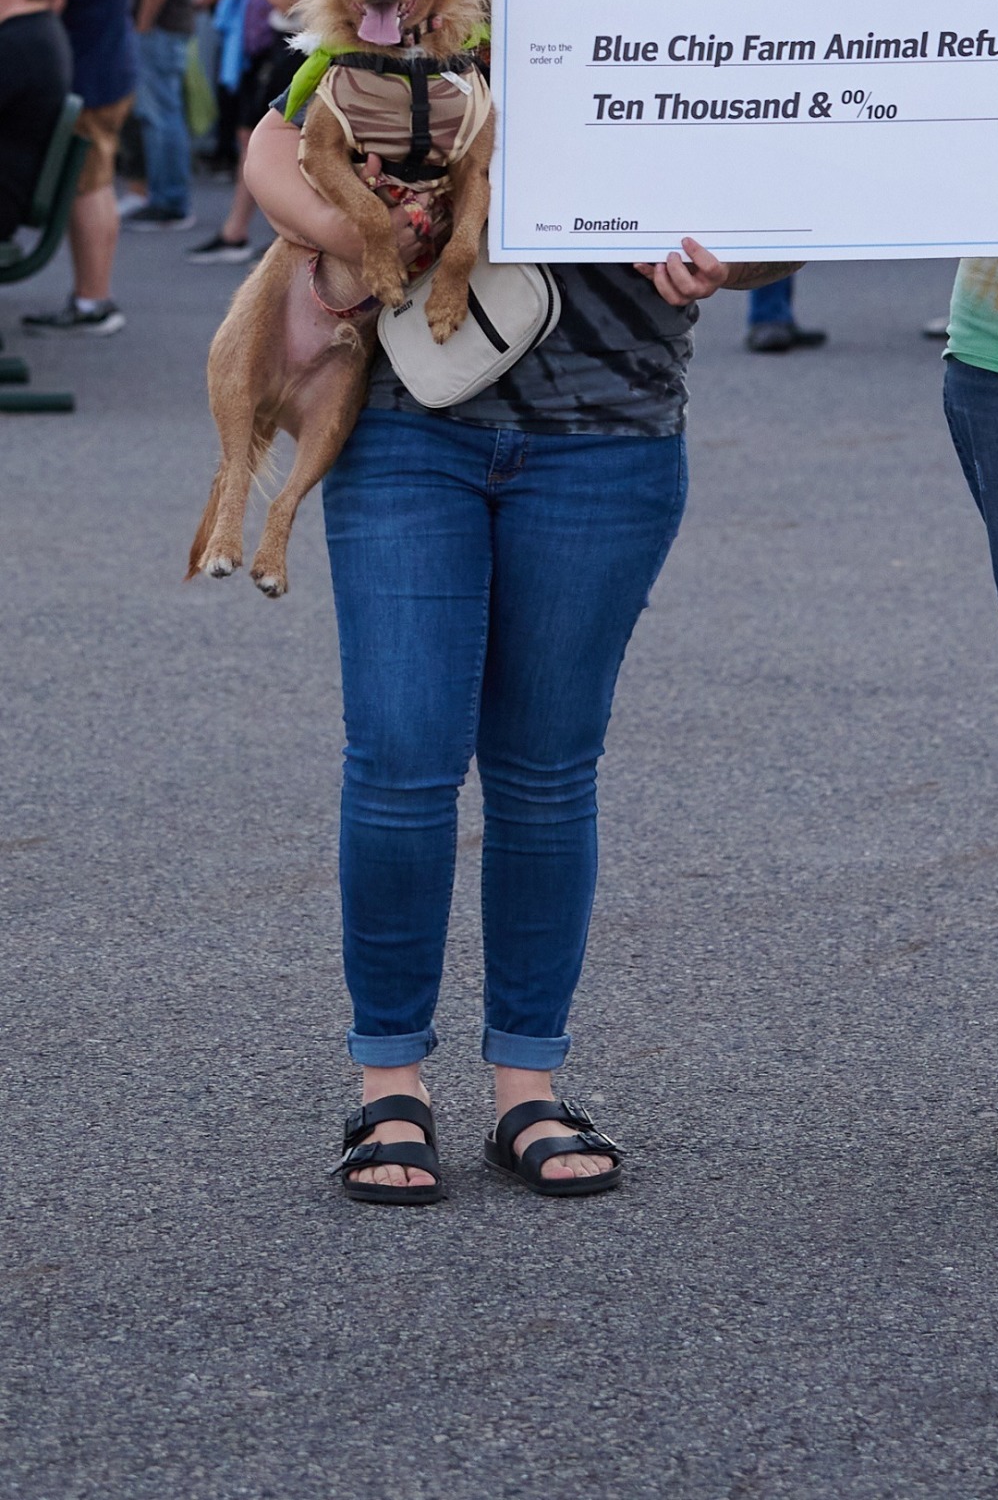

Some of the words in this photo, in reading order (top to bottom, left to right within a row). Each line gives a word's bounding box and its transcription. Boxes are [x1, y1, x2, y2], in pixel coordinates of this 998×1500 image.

[530, 43, 546, 53] Pay
[548, 44, 557, 52] to
[559, 44, 573, 52] the
[592, 35, 658, 62] Blue
[667, 33, 734, 68] Chip
[742, 34, 817, 62] Farm
[824, 31, 929, 61] Animal
[530, 56, 552, 65] order
[554, 56, 563, 65] of
[592, 93, 644, 121] Ten
[654, 91, 801, 121] Thousand
[808, 92, 833, 119] &
[841, 89, 898, 120] 00/100
[535, 223, 563, 232] Memo
[573, 216, 639, 231] Donation
